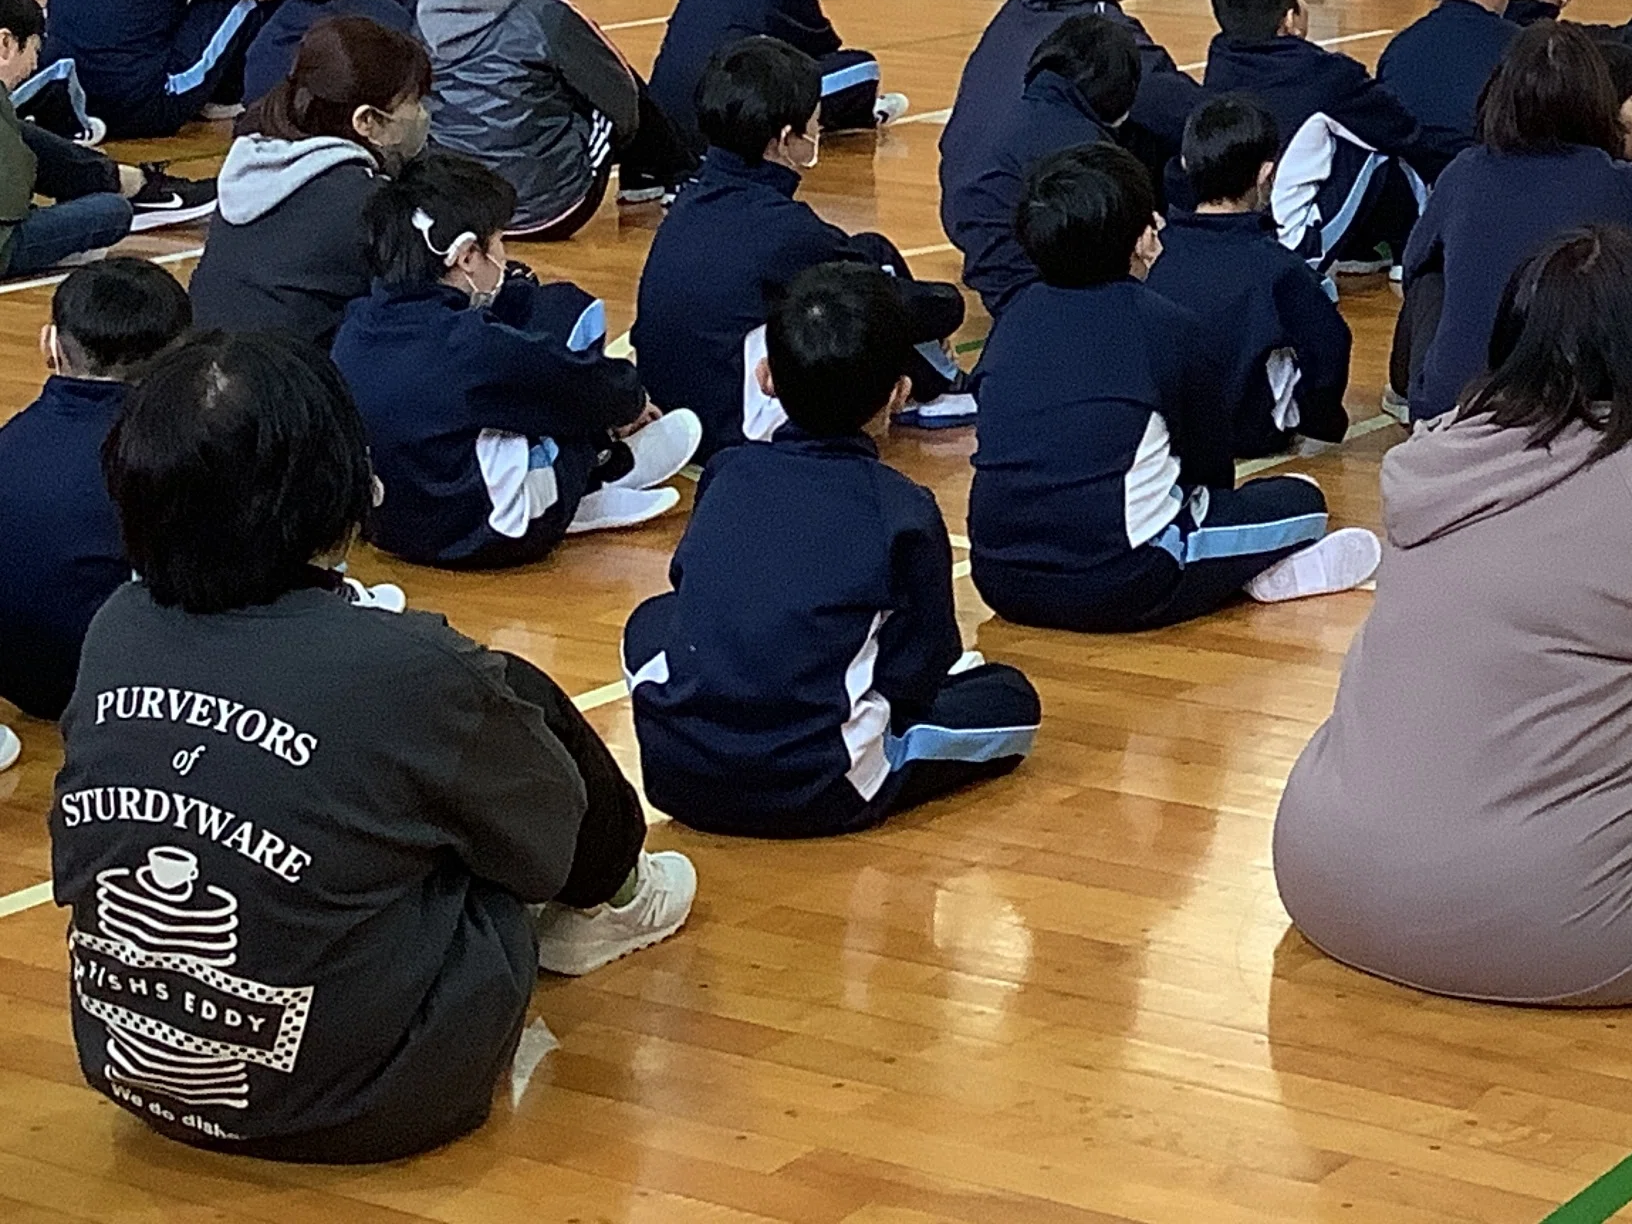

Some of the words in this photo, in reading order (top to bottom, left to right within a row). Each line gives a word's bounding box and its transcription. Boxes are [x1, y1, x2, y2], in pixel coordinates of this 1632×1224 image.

[95, 686, 318, 768] PURVEYORS
[172, 744, 206, 776] of
[61, 787, 312, 883] STURDYWARE
[184, 990, 267, 1033] EDDY
[110, 1082, 143, 1107] We
[148, 1101, 176, 1122] do
